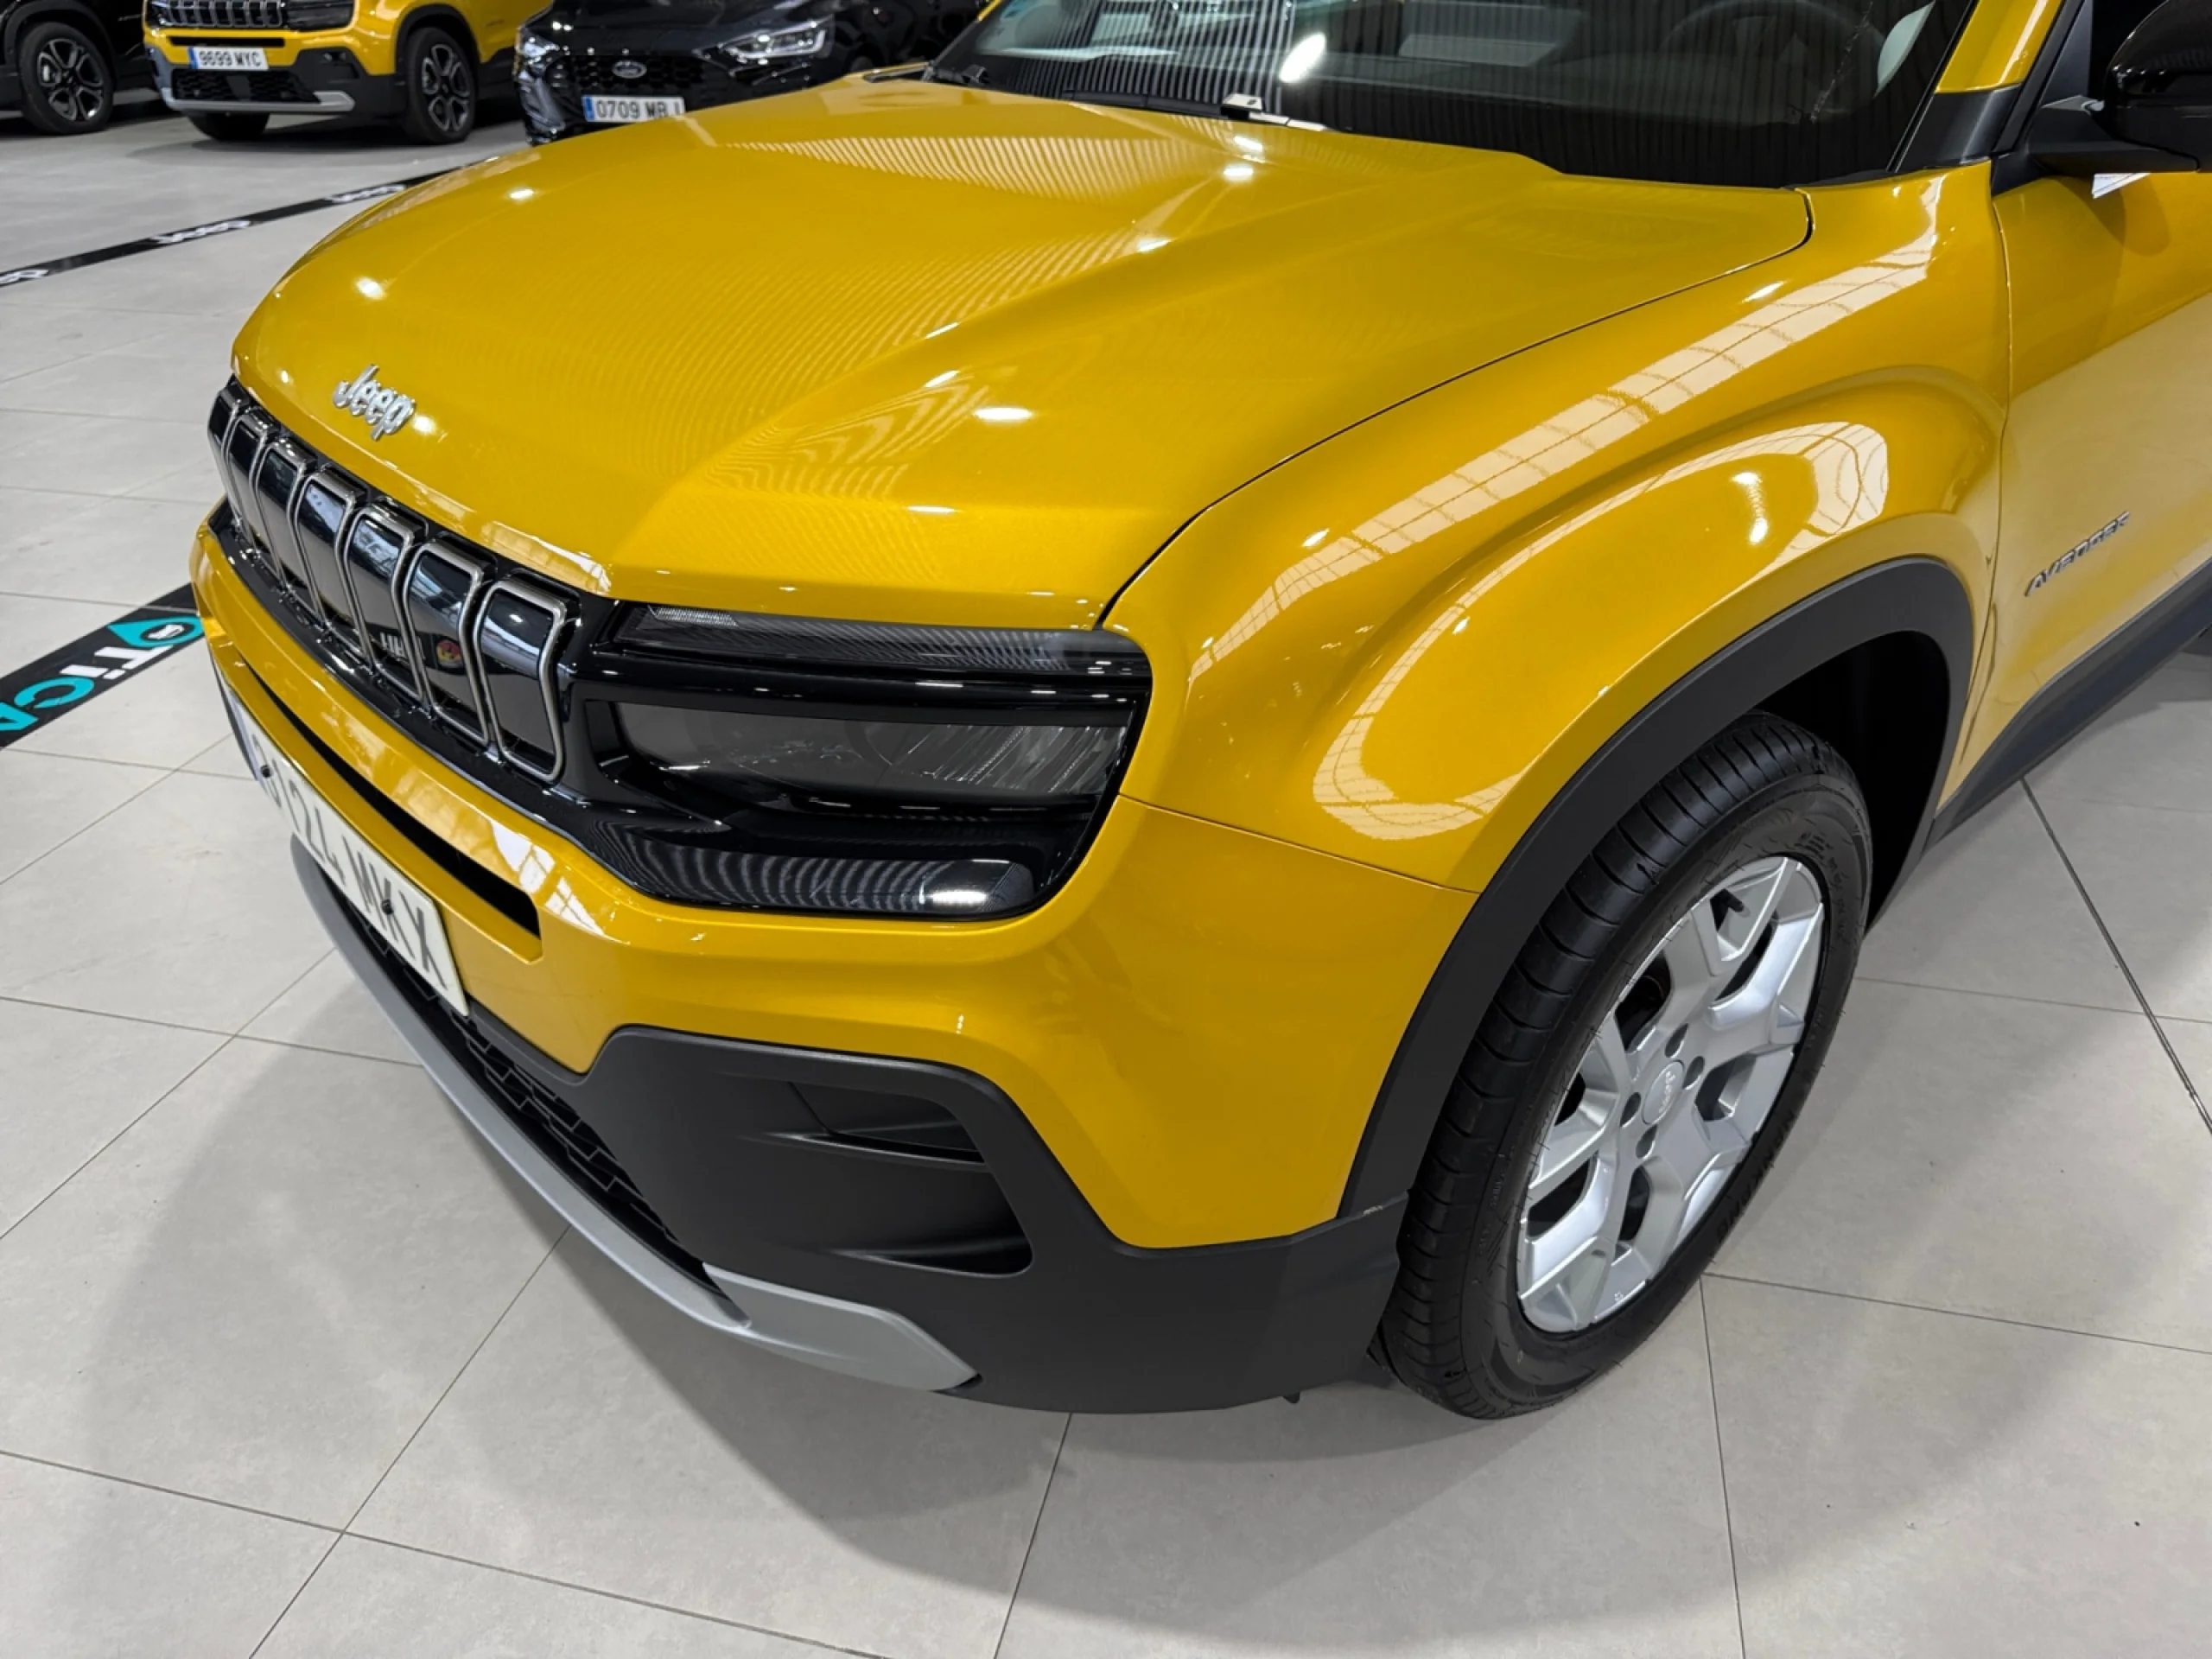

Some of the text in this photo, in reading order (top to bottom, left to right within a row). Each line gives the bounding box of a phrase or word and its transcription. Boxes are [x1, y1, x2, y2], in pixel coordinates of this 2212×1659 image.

[596, 100, 640, 118] 0709
[332, 363, 416, 442] Jeep
[341, 835, 449, 990] MKX
